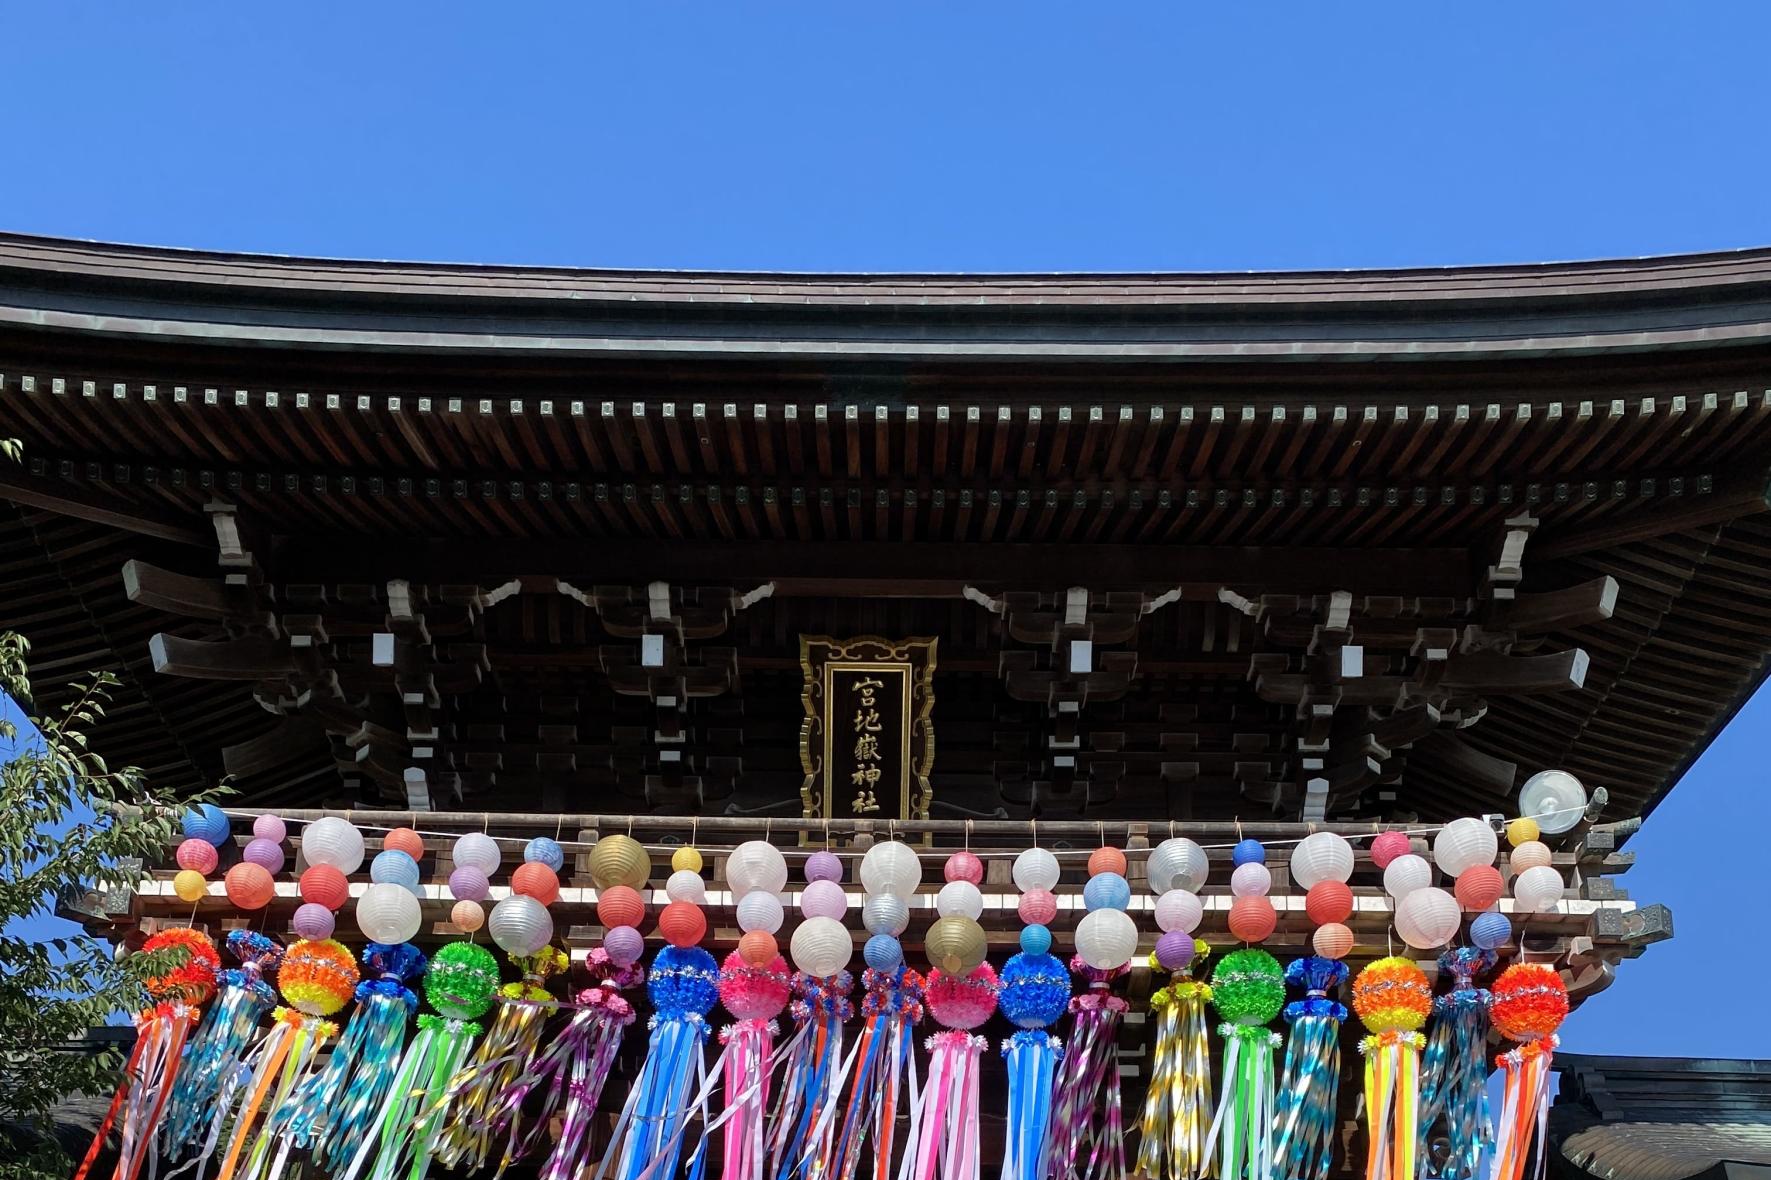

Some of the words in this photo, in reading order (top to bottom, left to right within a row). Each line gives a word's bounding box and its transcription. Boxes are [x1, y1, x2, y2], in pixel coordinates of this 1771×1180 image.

[851, 676, 884, 813] 宮地嶽神社
